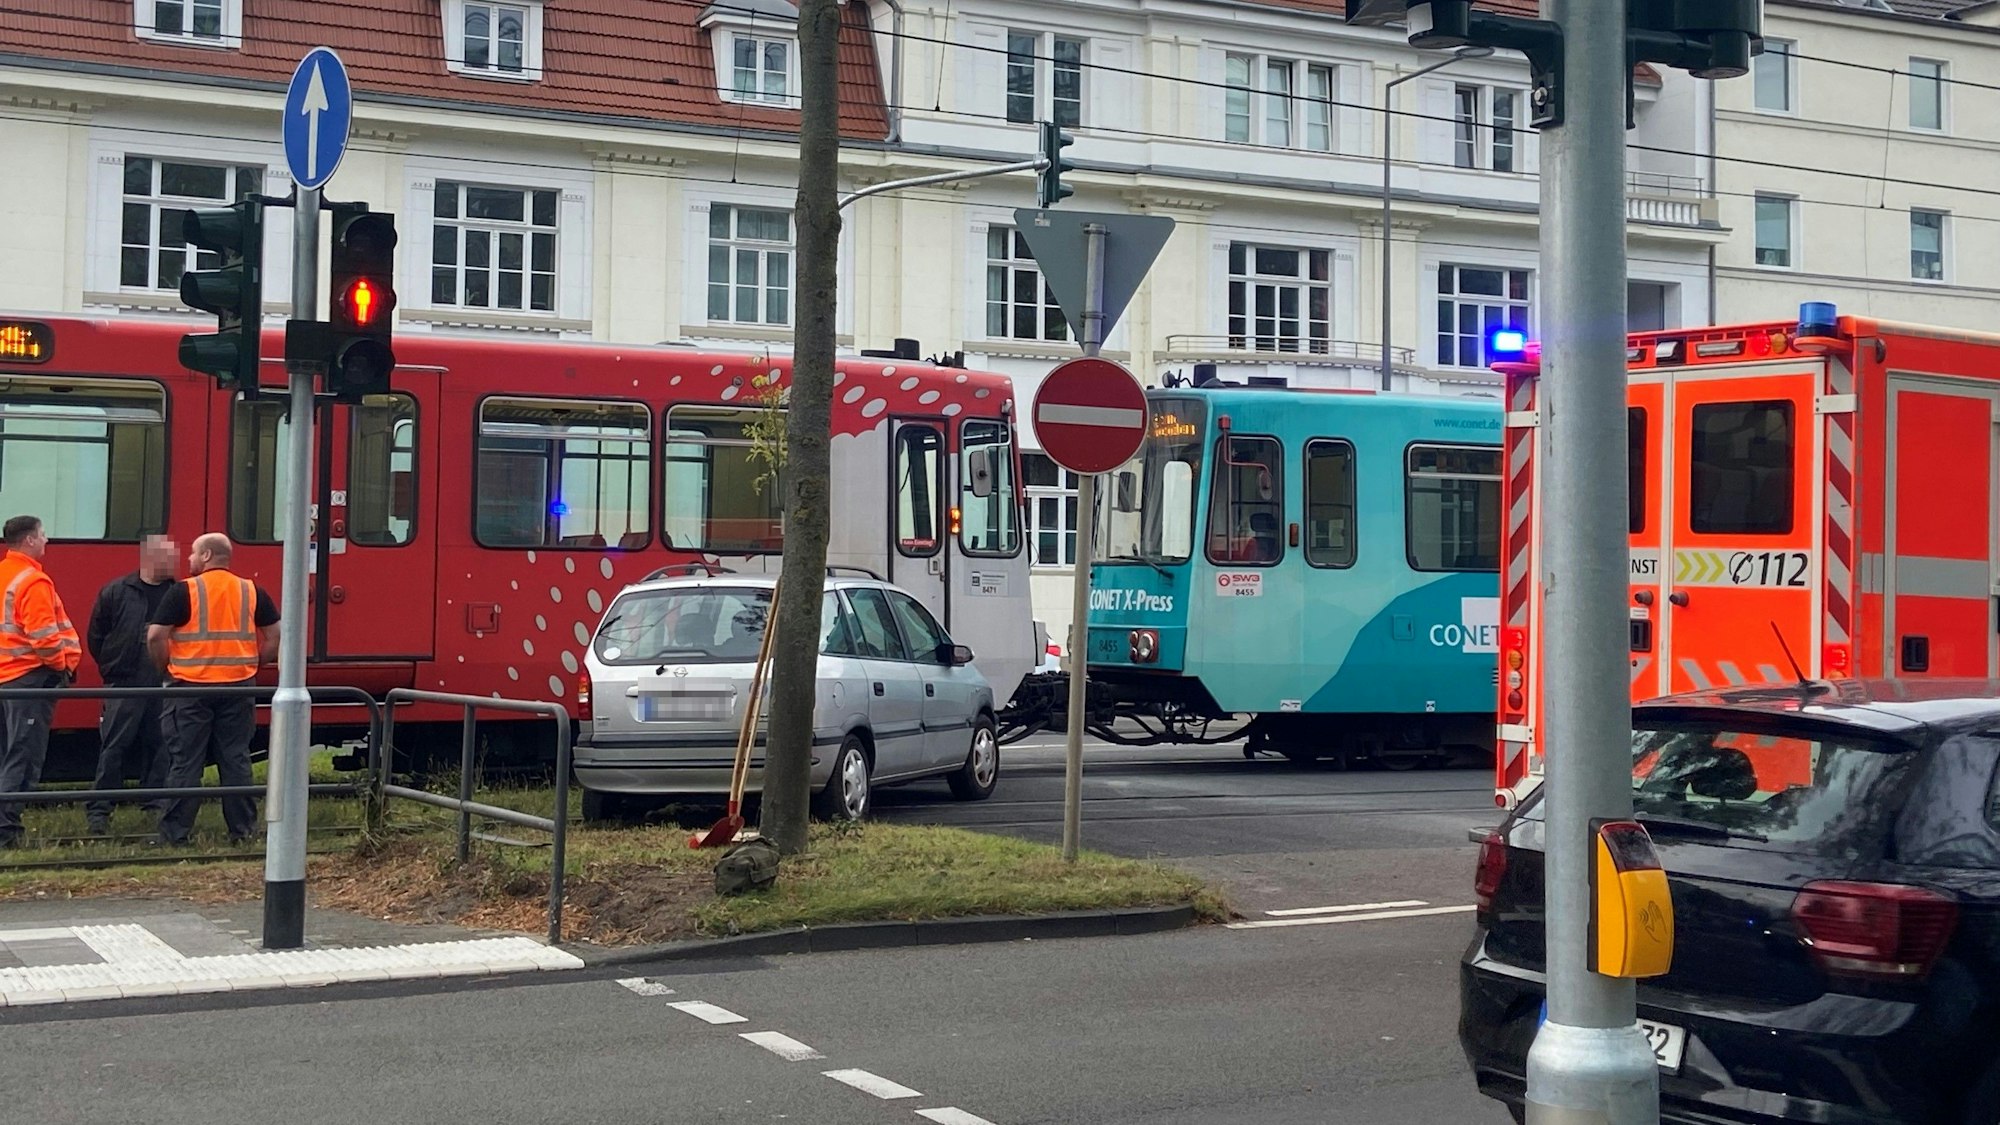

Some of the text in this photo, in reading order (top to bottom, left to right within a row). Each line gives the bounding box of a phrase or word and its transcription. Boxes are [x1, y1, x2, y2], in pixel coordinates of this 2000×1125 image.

[1433, 419, 1501, 430] www.conet.de
[1630, 559, 1658, 575] NST
[1758, 552, 1808, 587] 112
[982, 586, 997, 594] 8471
[1235, 588, 1255, 596] 8455
[1089, 589, 1174, 612] CONET X-Press
[1429, 623, 1500, 647] CONET
[1099, 639, 1119, 653] 8455
